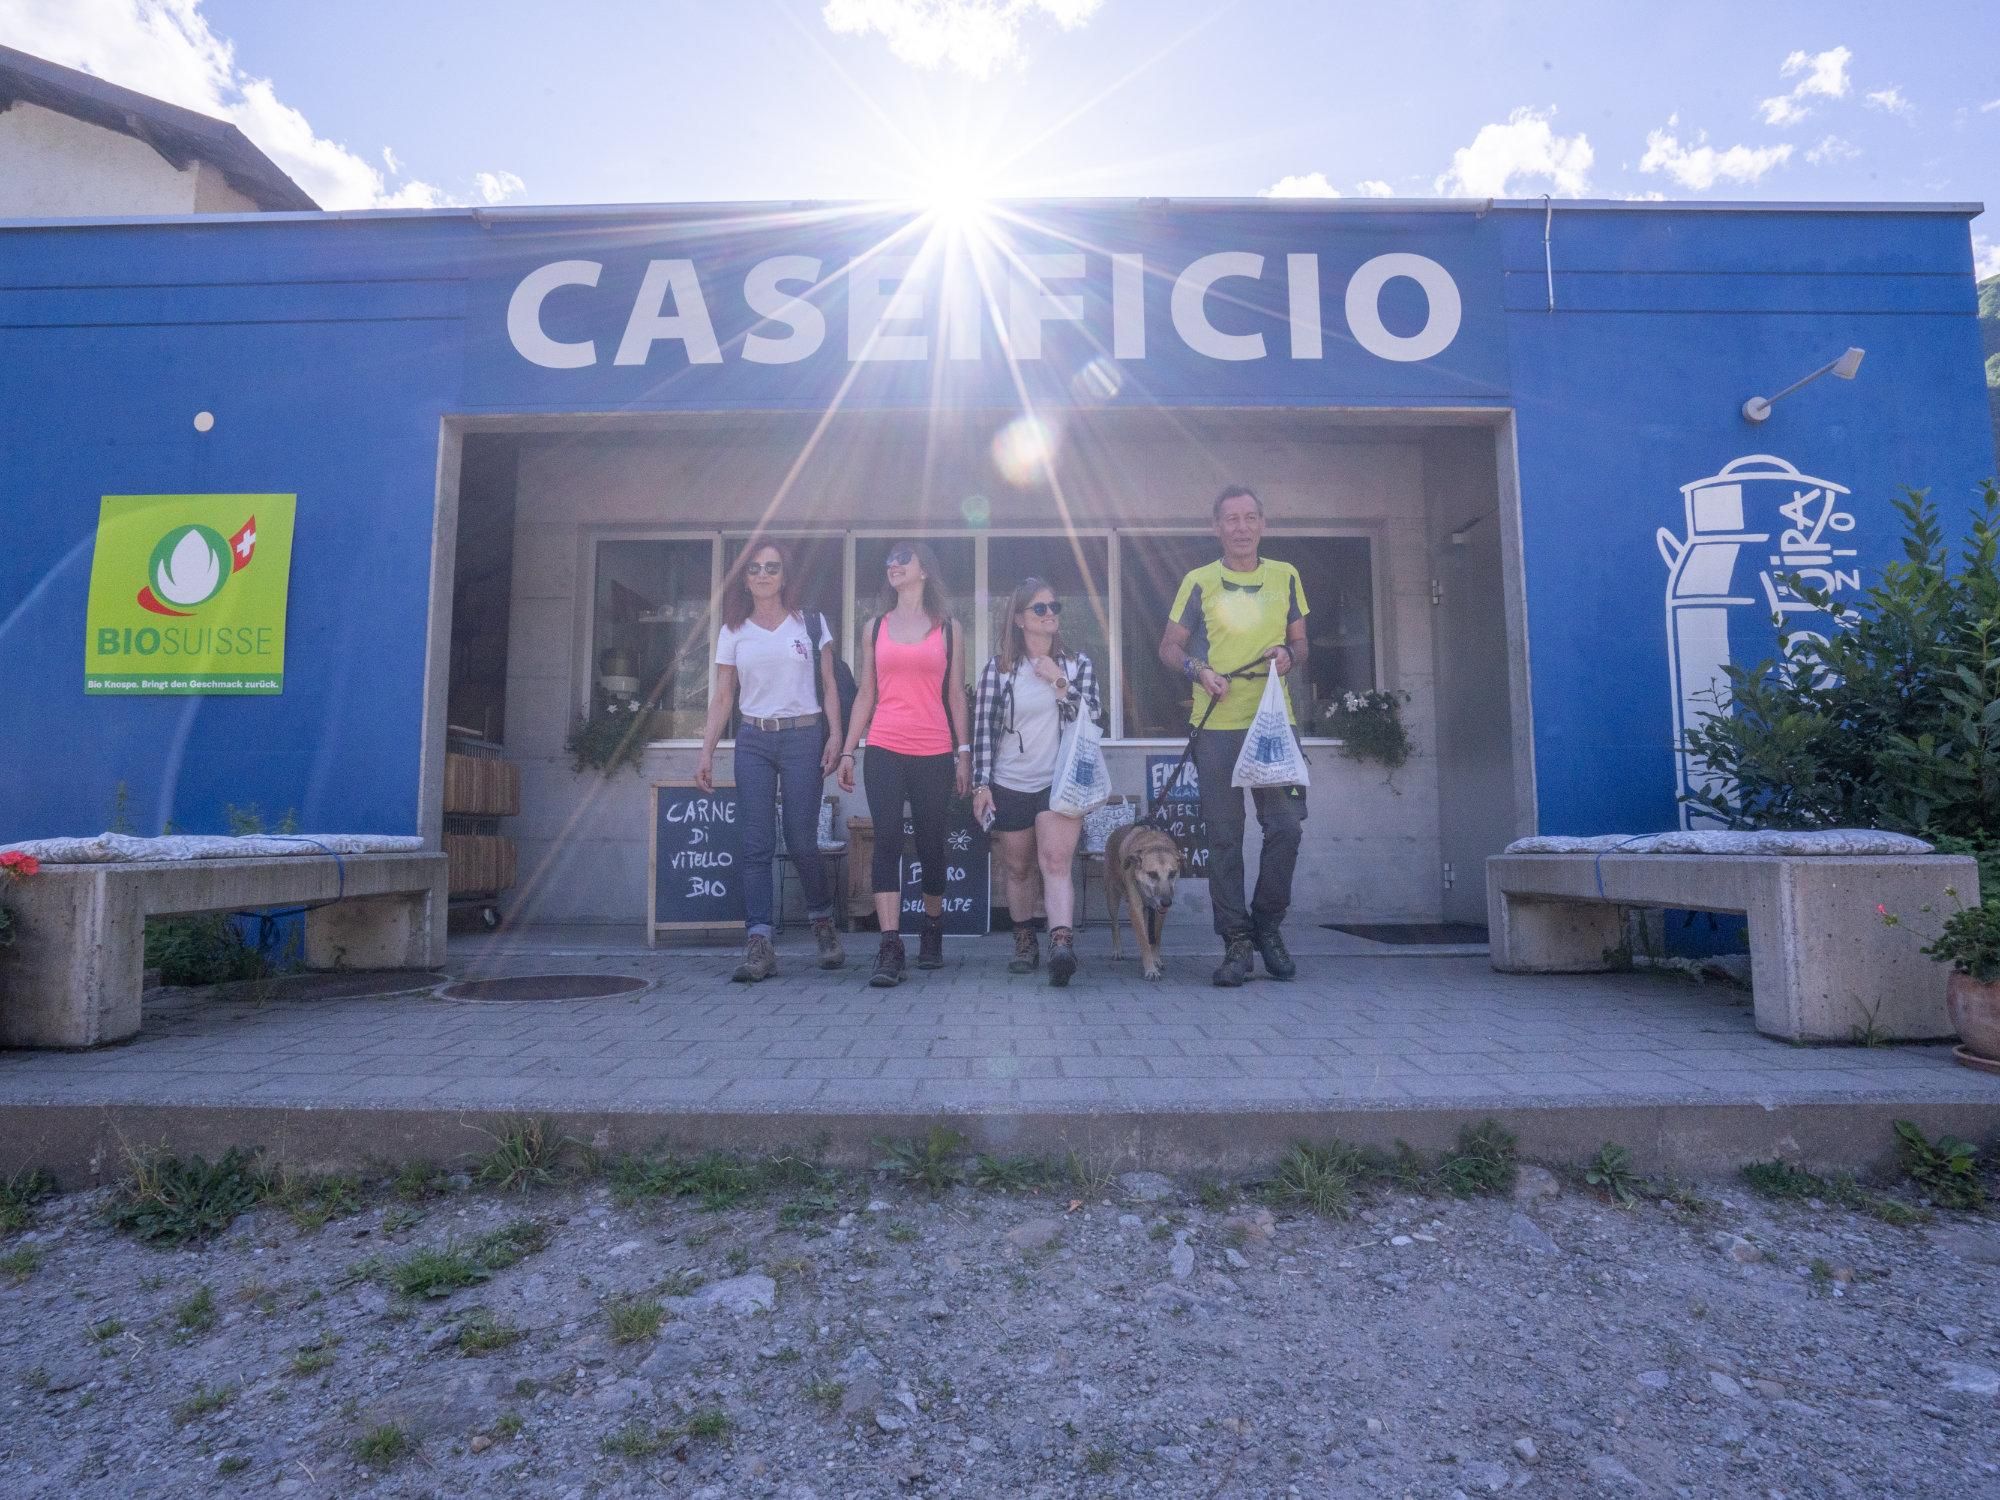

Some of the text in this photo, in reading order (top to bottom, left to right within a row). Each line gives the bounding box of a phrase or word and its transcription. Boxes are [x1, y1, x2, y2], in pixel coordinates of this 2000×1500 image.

[507, 251, 1462, 369] CASEIFICIO
[88, 680, 279, 690] Bio Knospe. Bringt den Geschmack zurück.
[666, 799, 736, 824] CARNE
[1200, 822, 1207, 836] 1
[1191, 847, 1209, 867] AP
[907, 862, 966, 885] BRO
[685, 876, 726, 898] BIO
